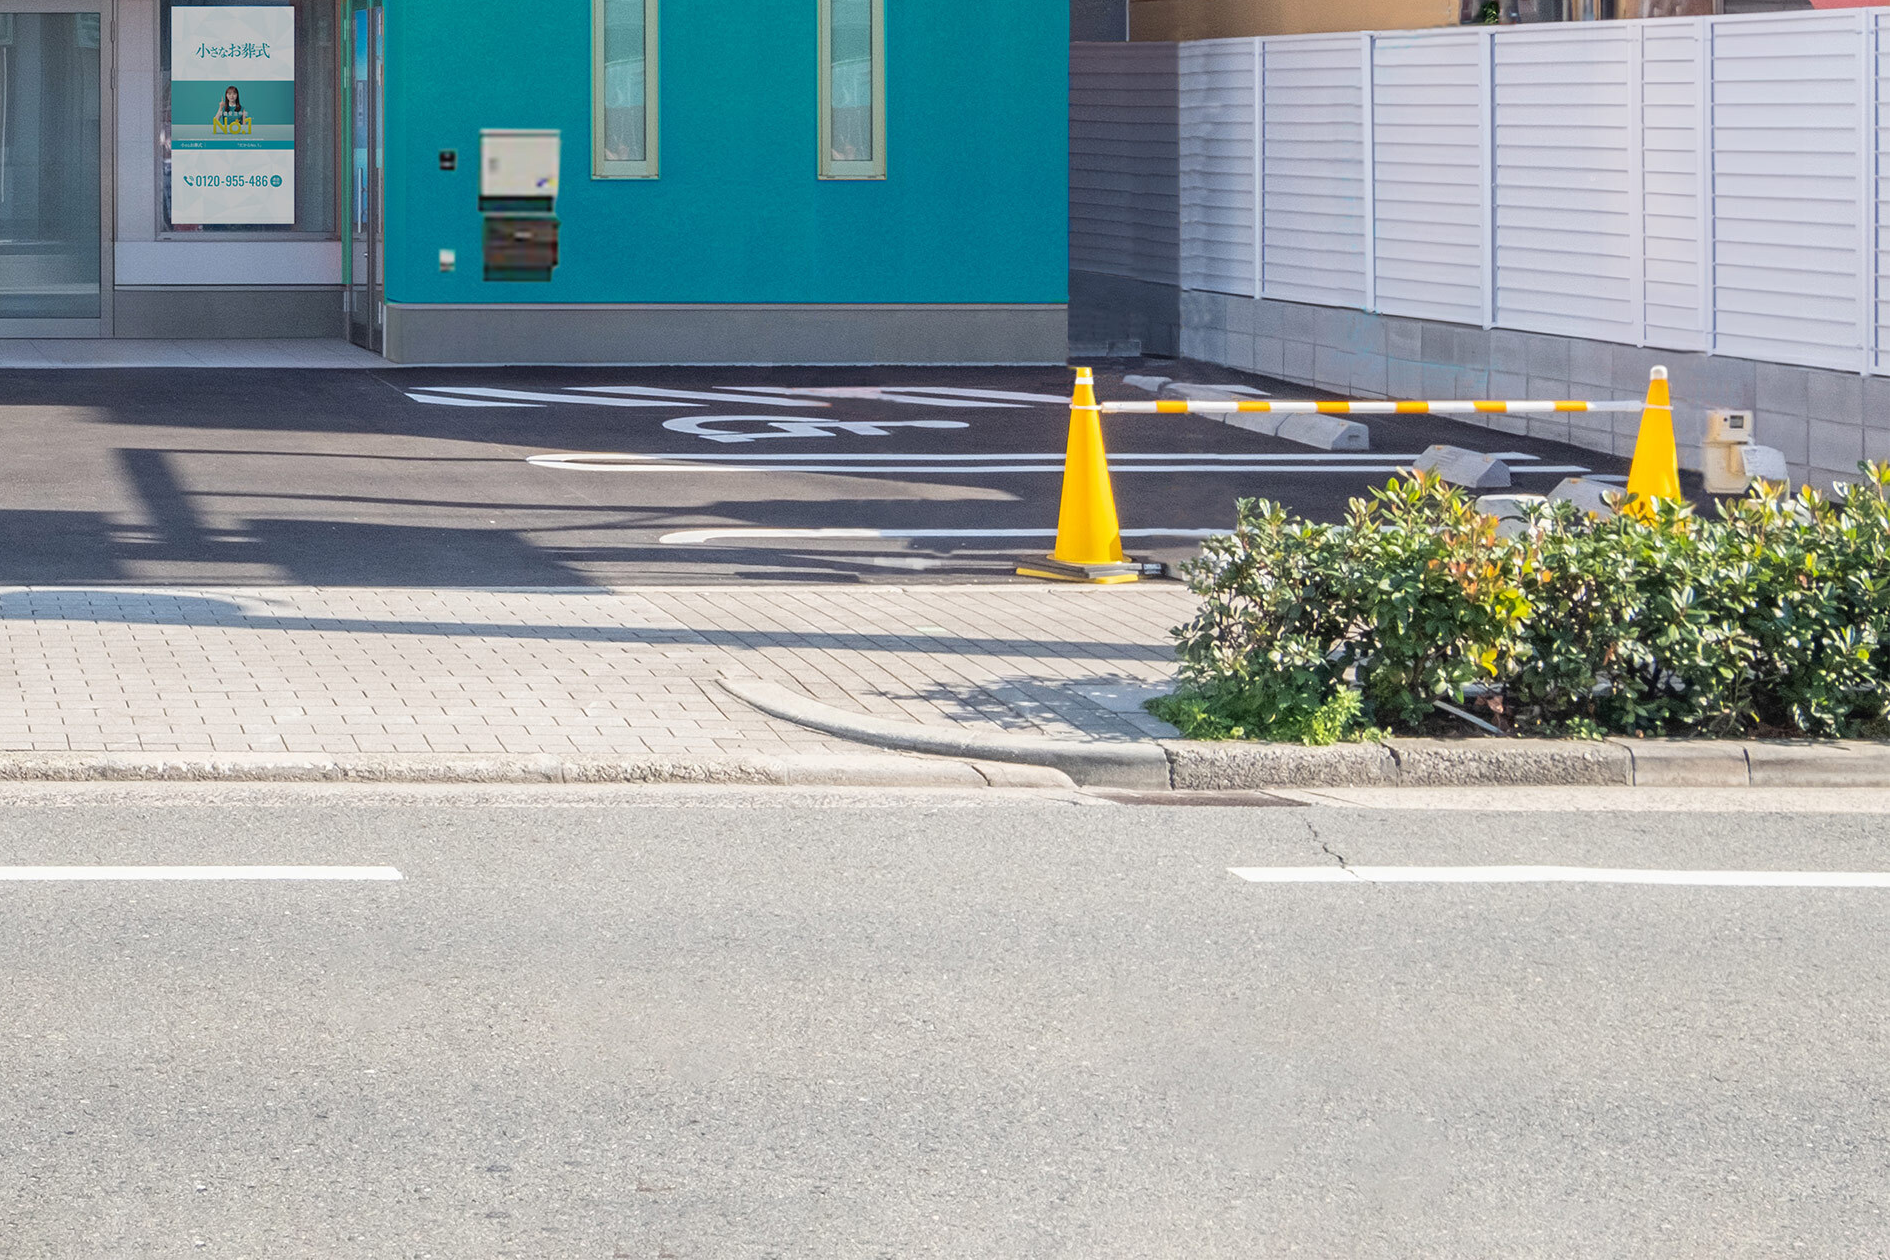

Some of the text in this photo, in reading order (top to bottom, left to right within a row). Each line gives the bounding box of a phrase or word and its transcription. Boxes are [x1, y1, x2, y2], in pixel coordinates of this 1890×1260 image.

[195, 42, 271, 59] 小さなお葬式
[213, 116, 252, 135] No.1
[195, 174, 269, 187] 0120-955-486
